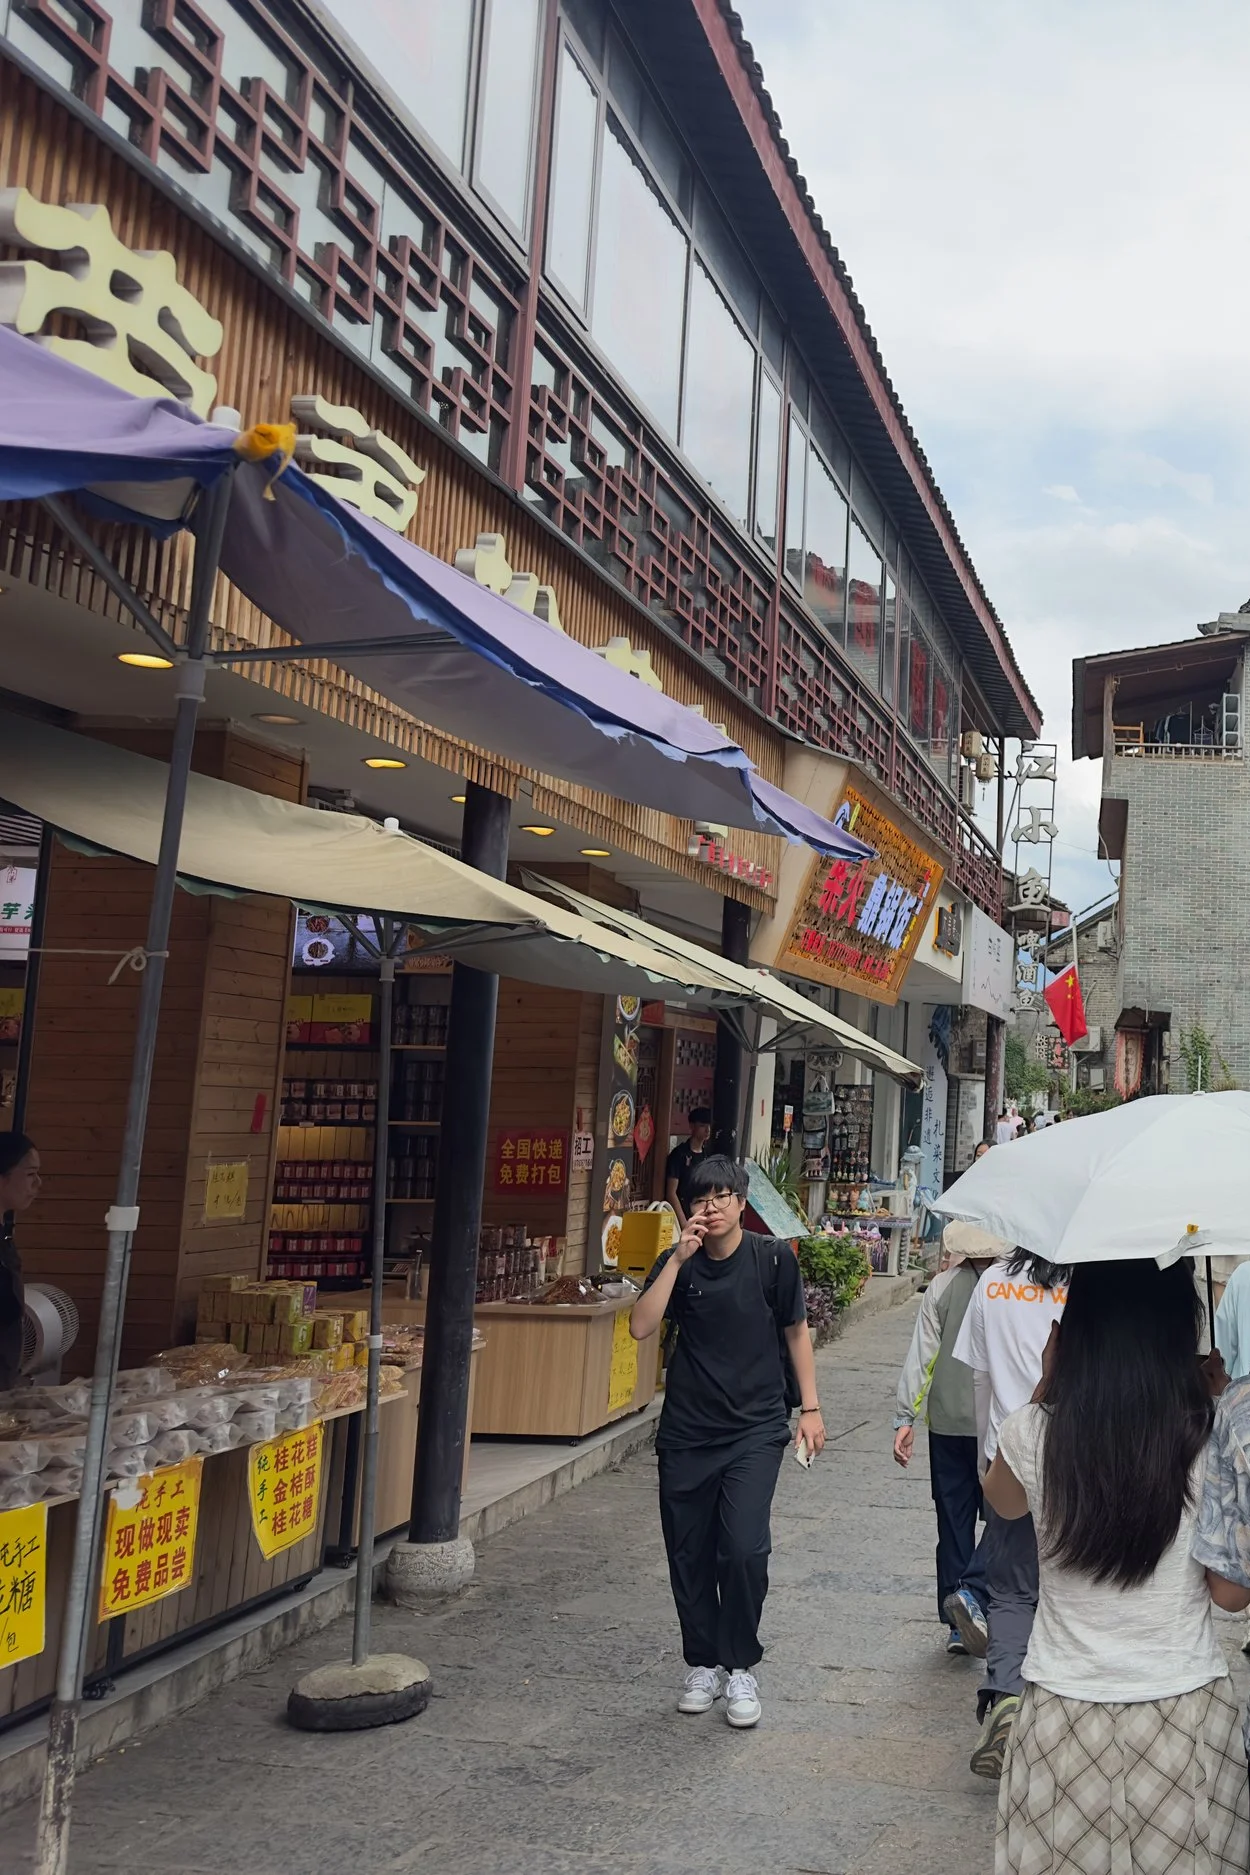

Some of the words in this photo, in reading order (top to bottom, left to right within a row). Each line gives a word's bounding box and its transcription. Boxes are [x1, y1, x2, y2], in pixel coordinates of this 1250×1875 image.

[1007, 739, 1059, 913] 江小鱼
[1010, 928, 1042, 1012] 啤酒鱼
[501, 1138, 563, 1160] 全国快递
[574, 1137, 592, 1155] 招工
[500, 1163, 561, 1185] 免费打包
[274, 1433, 318, 1473] 桂花糕
[257, 1454, 270, 1524] 纯手工
[273, 1464, 316, 1505] 金桔酥
[115, 1506, 190, 1559] 现做现卖
[271, 1494, 313, 1536] 桂花糖
[111, 1547, 186, 1604] 免费品尝
